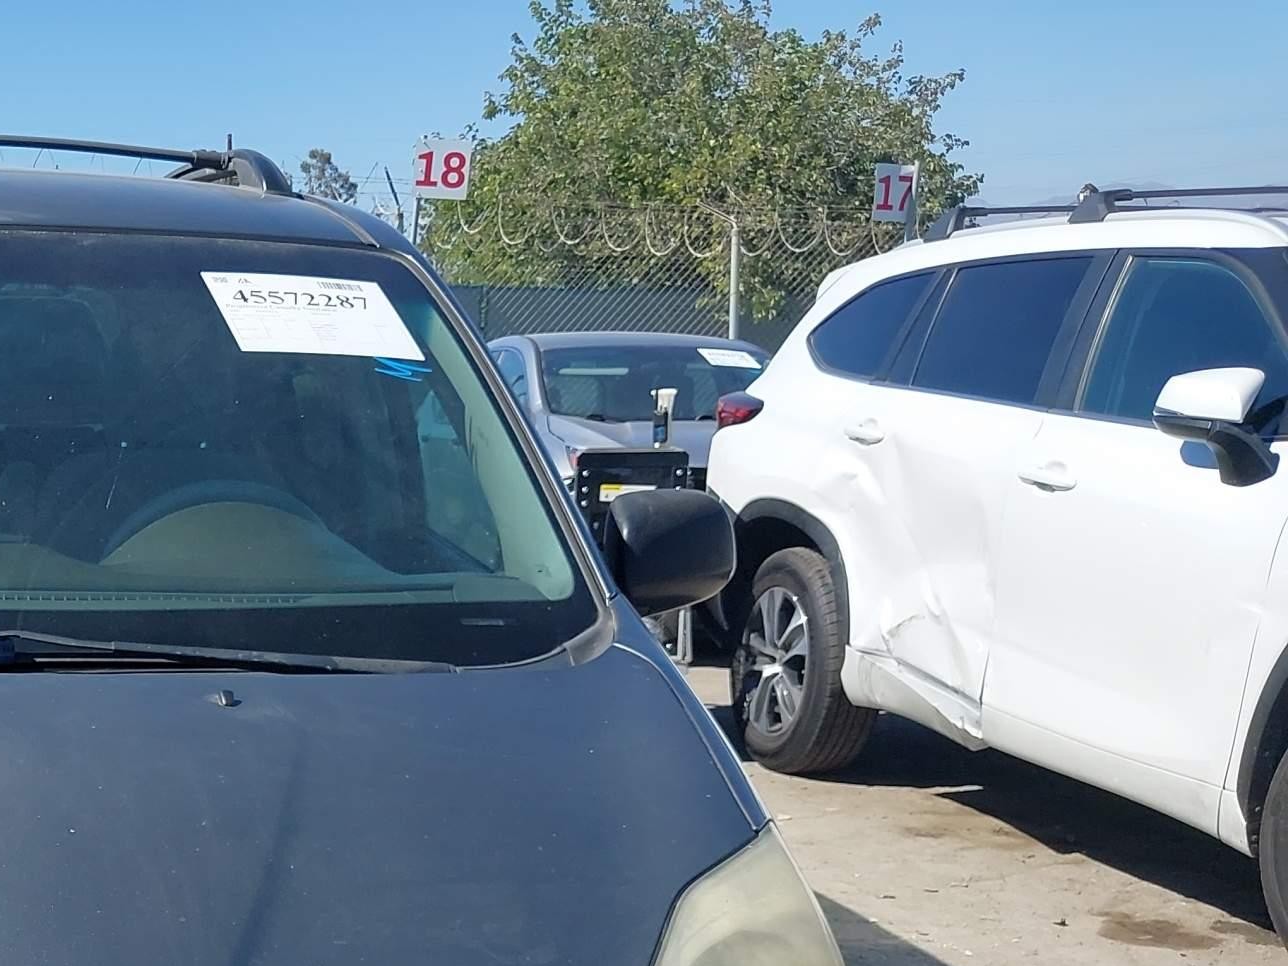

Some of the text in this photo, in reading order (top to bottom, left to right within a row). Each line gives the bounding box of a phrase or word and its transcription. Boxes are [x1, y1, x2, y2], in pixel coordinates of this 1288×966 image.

[415, 151, 466, 188] 18
[876, 175, 913, 211] 17
[233, 289, 367, 310] 45572287
